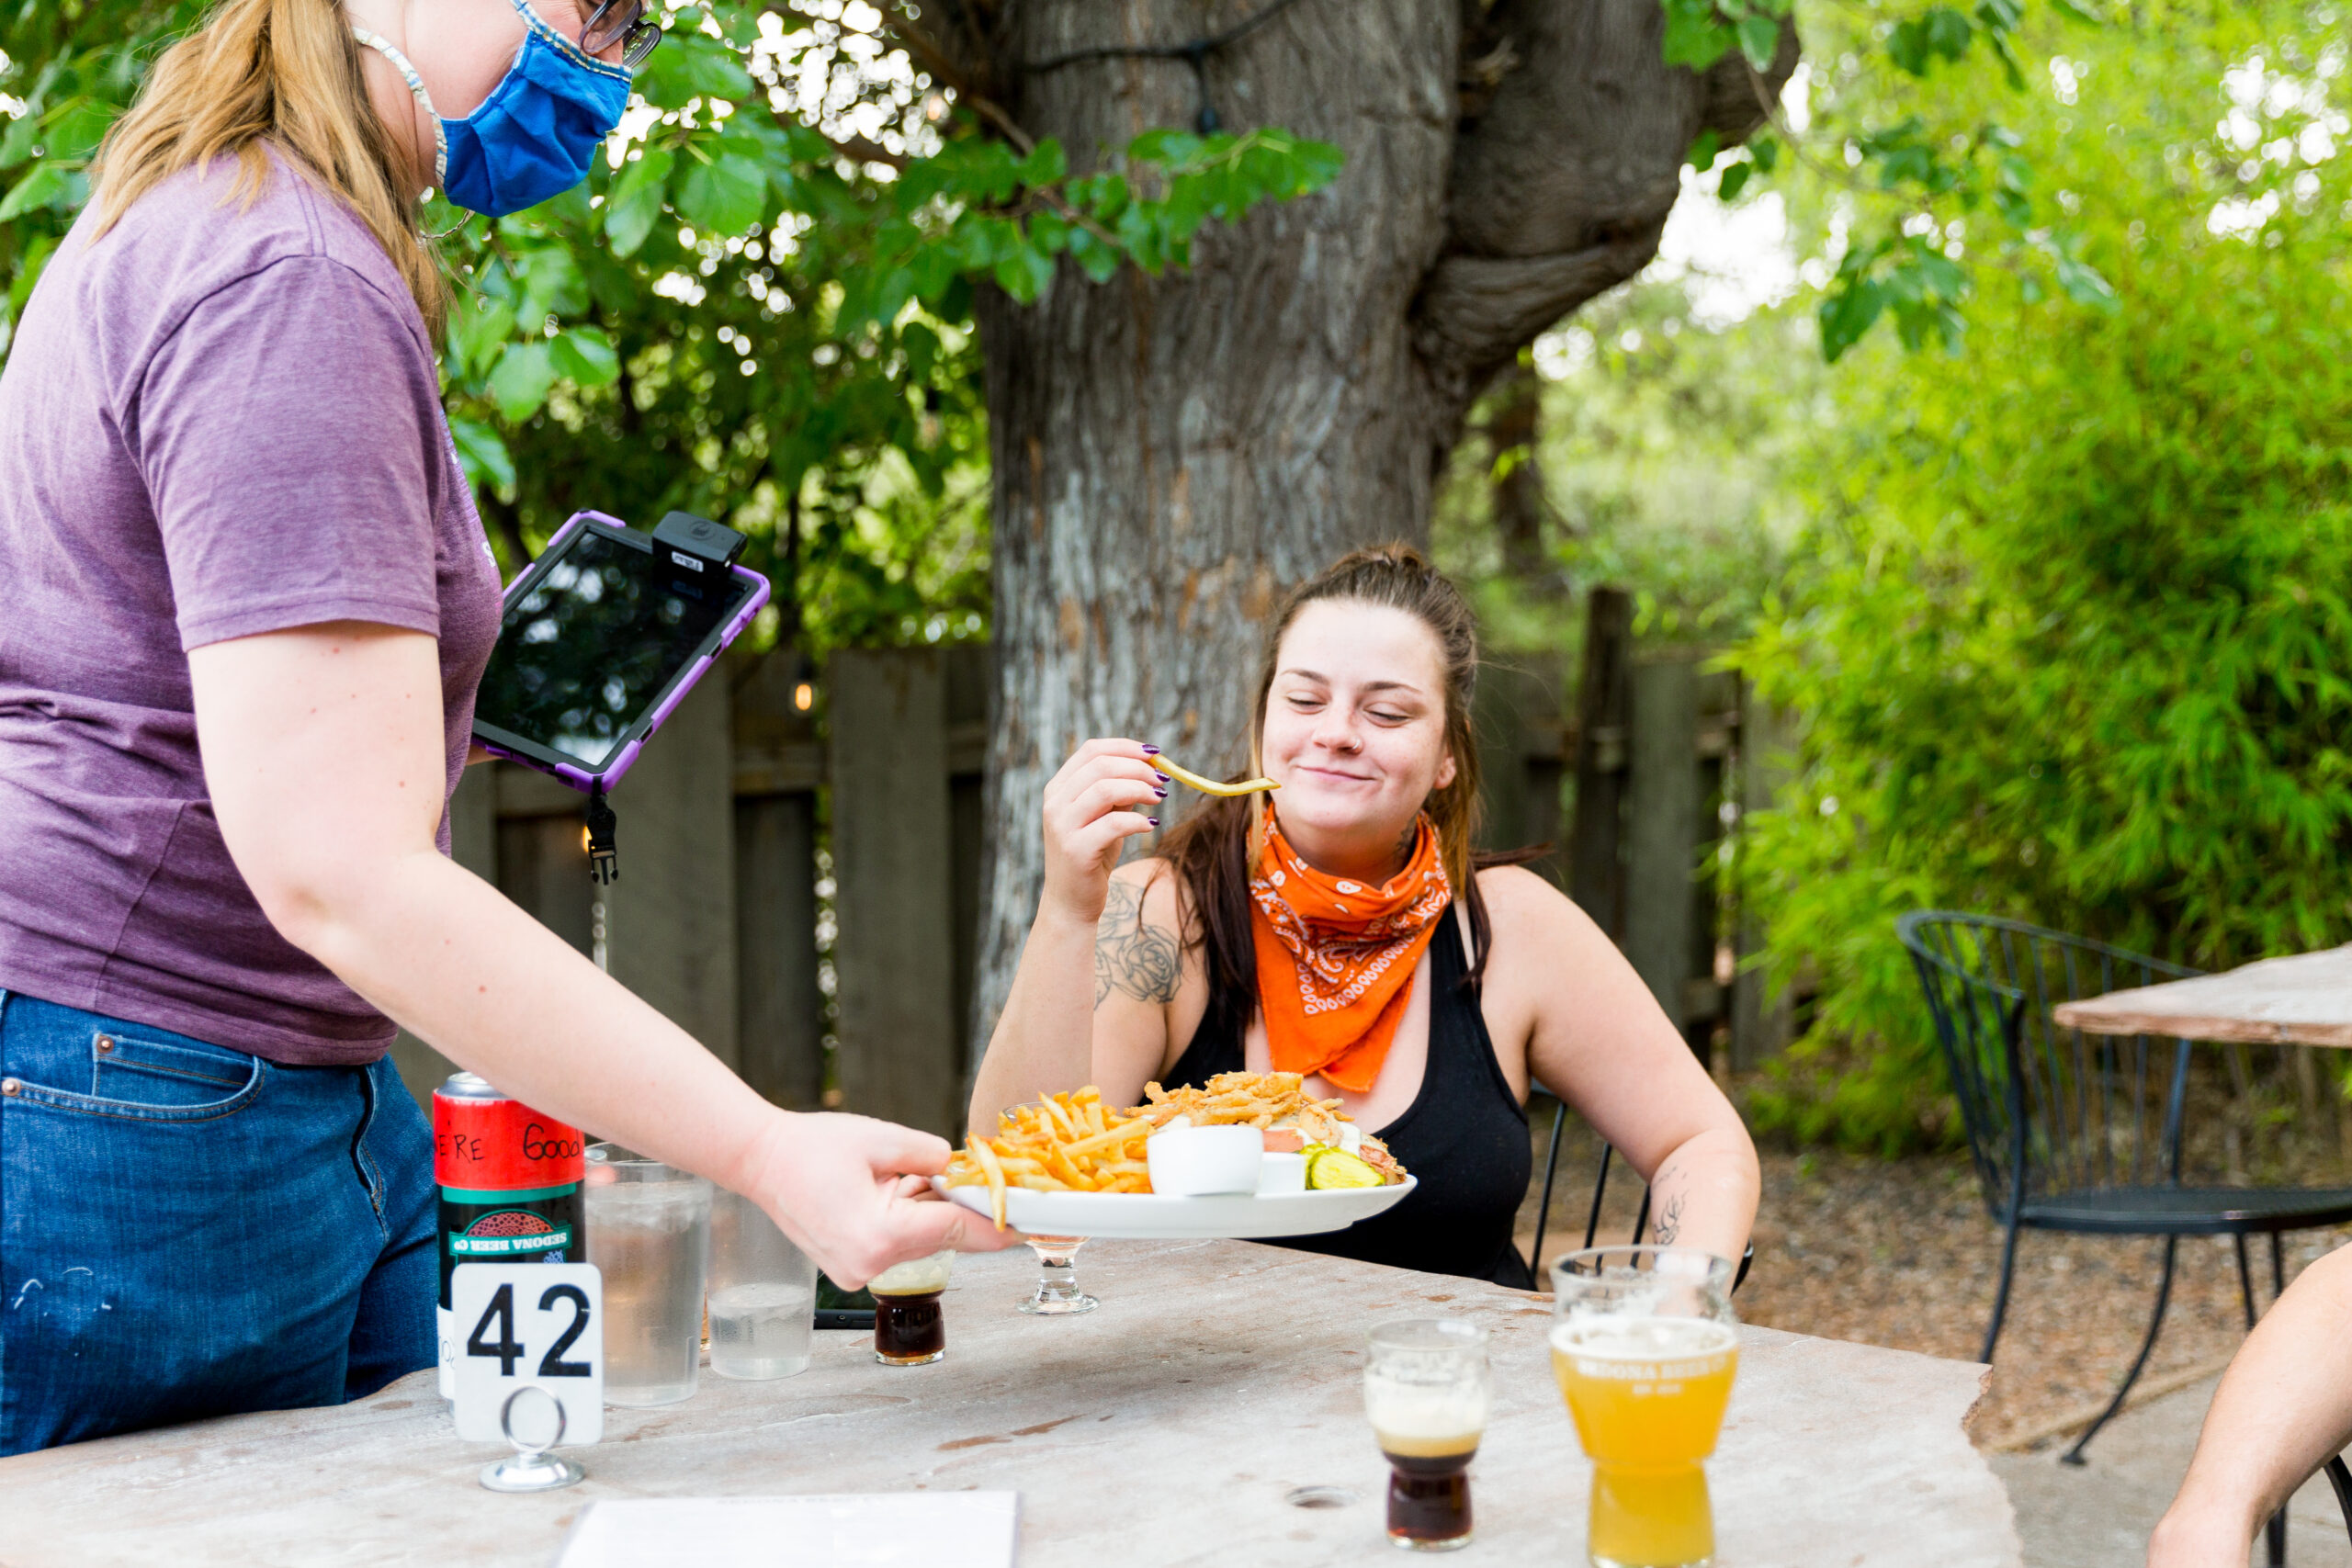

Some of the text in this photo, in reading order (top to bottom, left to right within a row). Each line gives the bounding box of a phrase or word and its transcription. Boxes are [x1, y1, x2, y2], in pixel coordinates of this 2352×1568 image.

[435, 1120, 581, 1164] E'RE Good
[470, 1239, 510, 1252] BEER
[512, 1232, 568, 1250] SEDONA
[467, 1283, 592, 1377] 42
